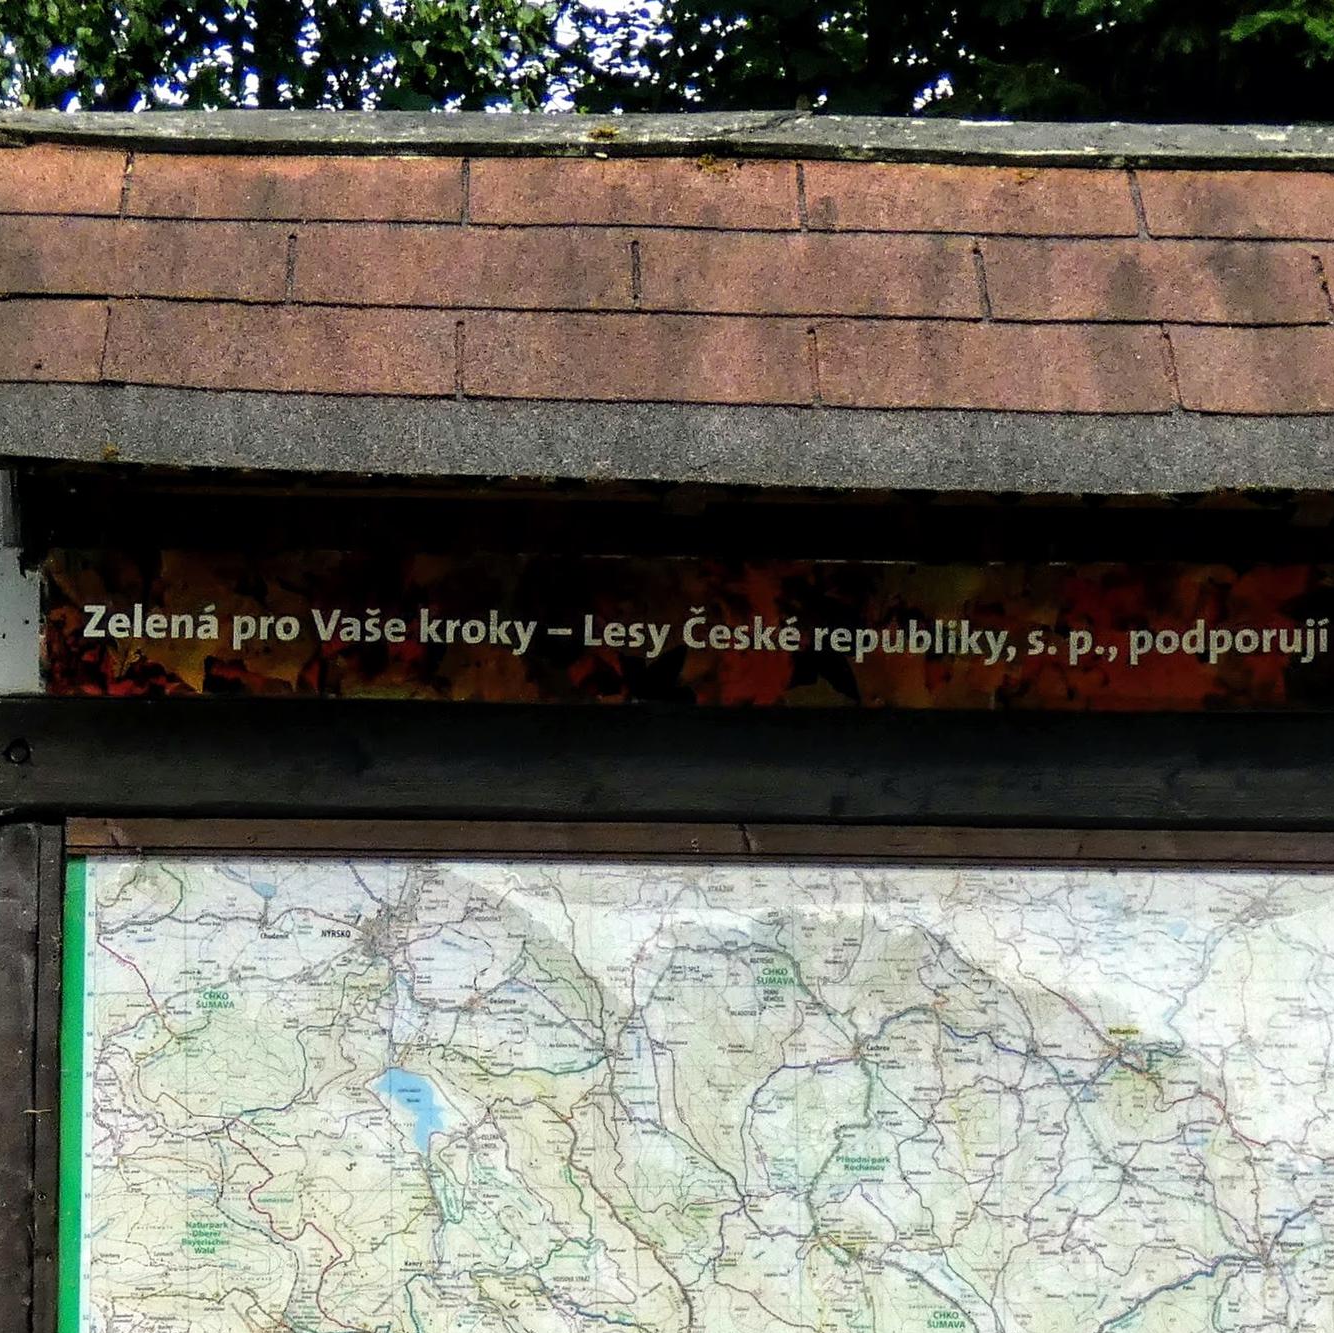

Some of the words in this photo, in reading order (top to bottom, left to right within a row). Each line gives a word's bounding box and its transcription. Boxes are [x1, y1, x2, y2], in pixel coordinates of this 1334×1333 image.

[83, 604, 219, 640] Zelená
[232, 615, 300, 650] pro
[311, 608, 407, 643] Vaše
[420, 609, 537, 655] kroky
[584, 614, 671, 657] Lesy
[683, 607, 801, 650] České
[813, 616, 1017, 664] republiky,
[1028, 630, 1056, 655] s.
[1069, 631, 1118, 665] p.,
[1130, 619, 1329, 665] podporují
